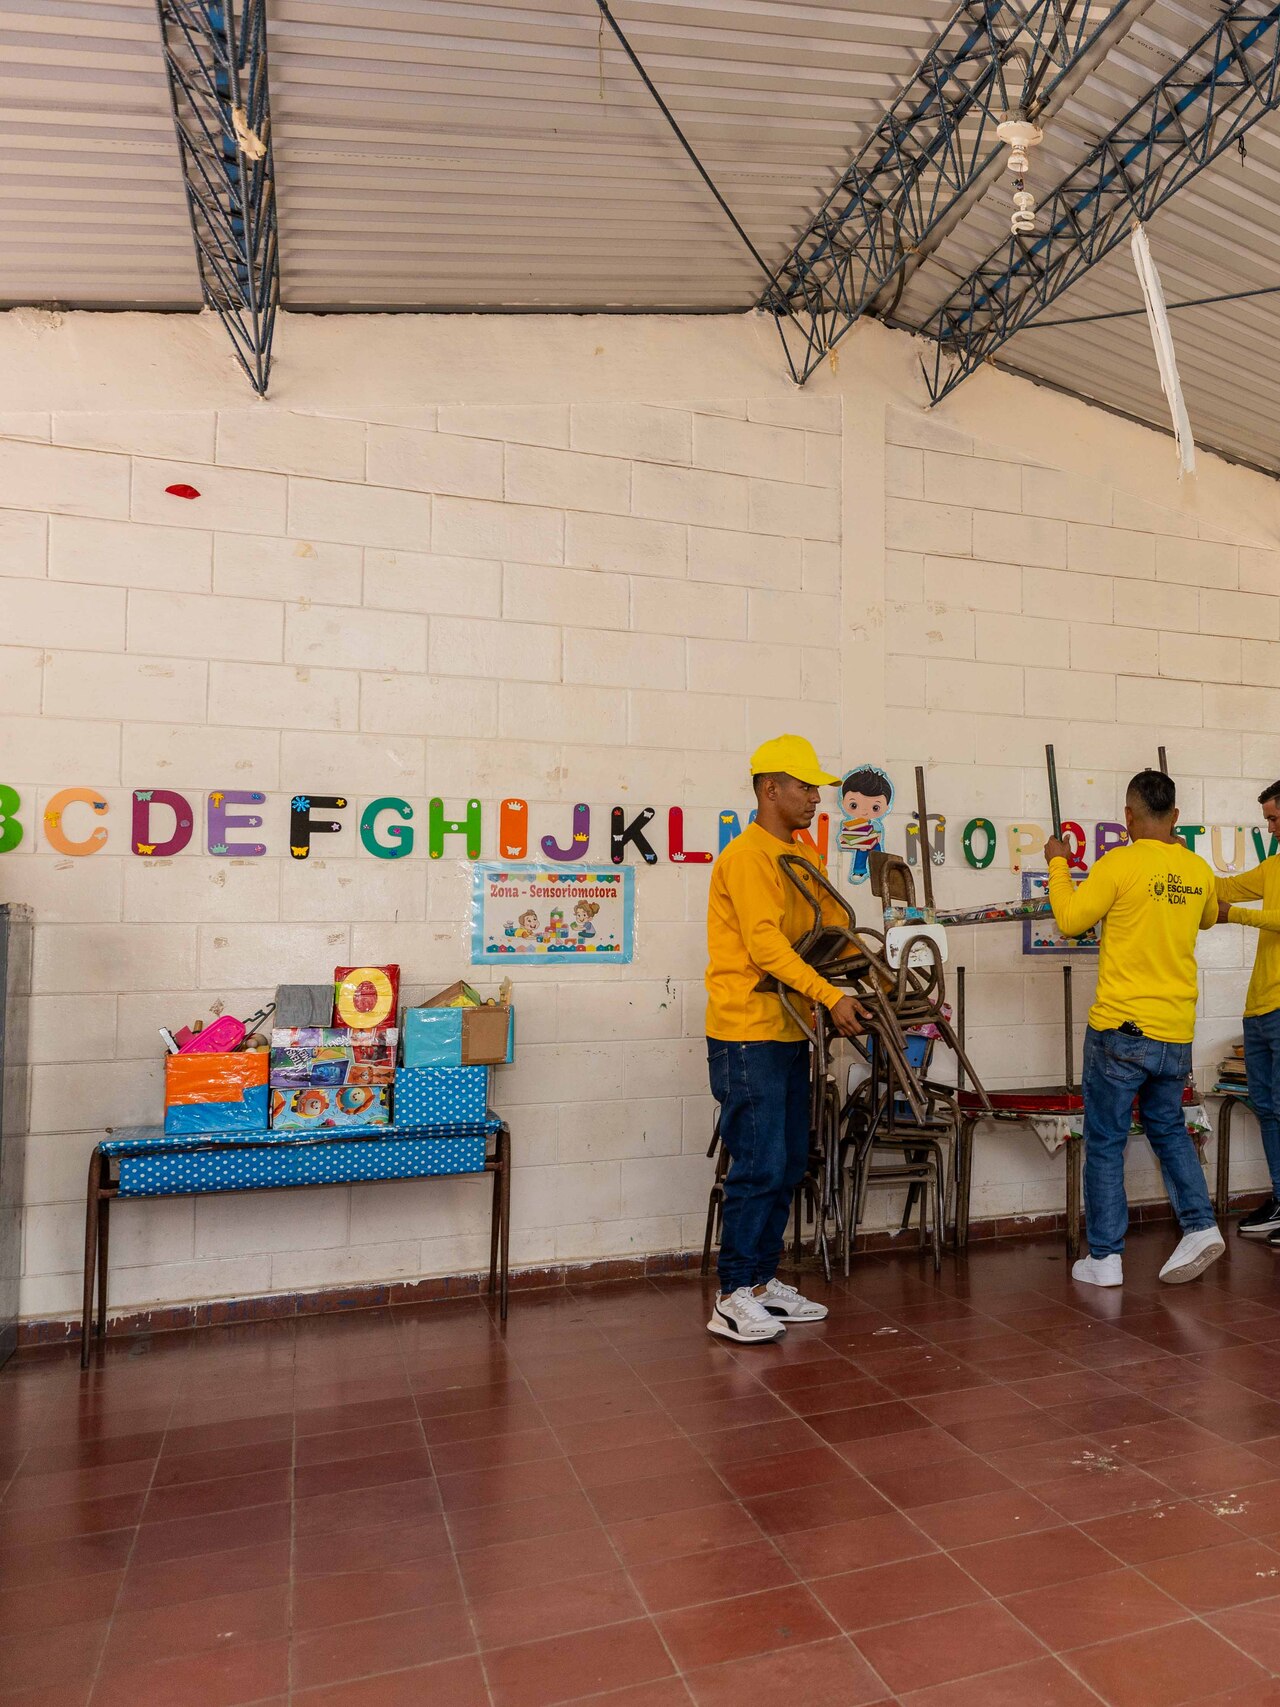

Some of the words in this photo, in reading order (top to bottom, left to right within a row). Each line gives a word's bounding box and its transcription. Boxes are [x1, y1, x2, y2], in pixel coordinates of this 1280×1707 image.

[43, 788, 109, 857] C
[132, 790, 194, 857] D
[208, 790, 267, 857] E
[290, 796, 347, 860] F
[360, 797, 414, 859] G
[429, 797, 481, 860] H
[500, 798, 528, 860] I
[541, 803, 590, 861] J
[611, 806, 658, 865] K
[669, 806, 714, 863] L
[963, 817, 996, 869] O
[1007, 823, 1046, 875] P
[1211, 825, 1246, 873] U
[1167, 873, 1183, 885] DOS
[490, 884, 519, 898] Zona
[529, 884, 618, 899] Sensoriomotora
[1167, 884, 1203, 896] ESCUELAS
